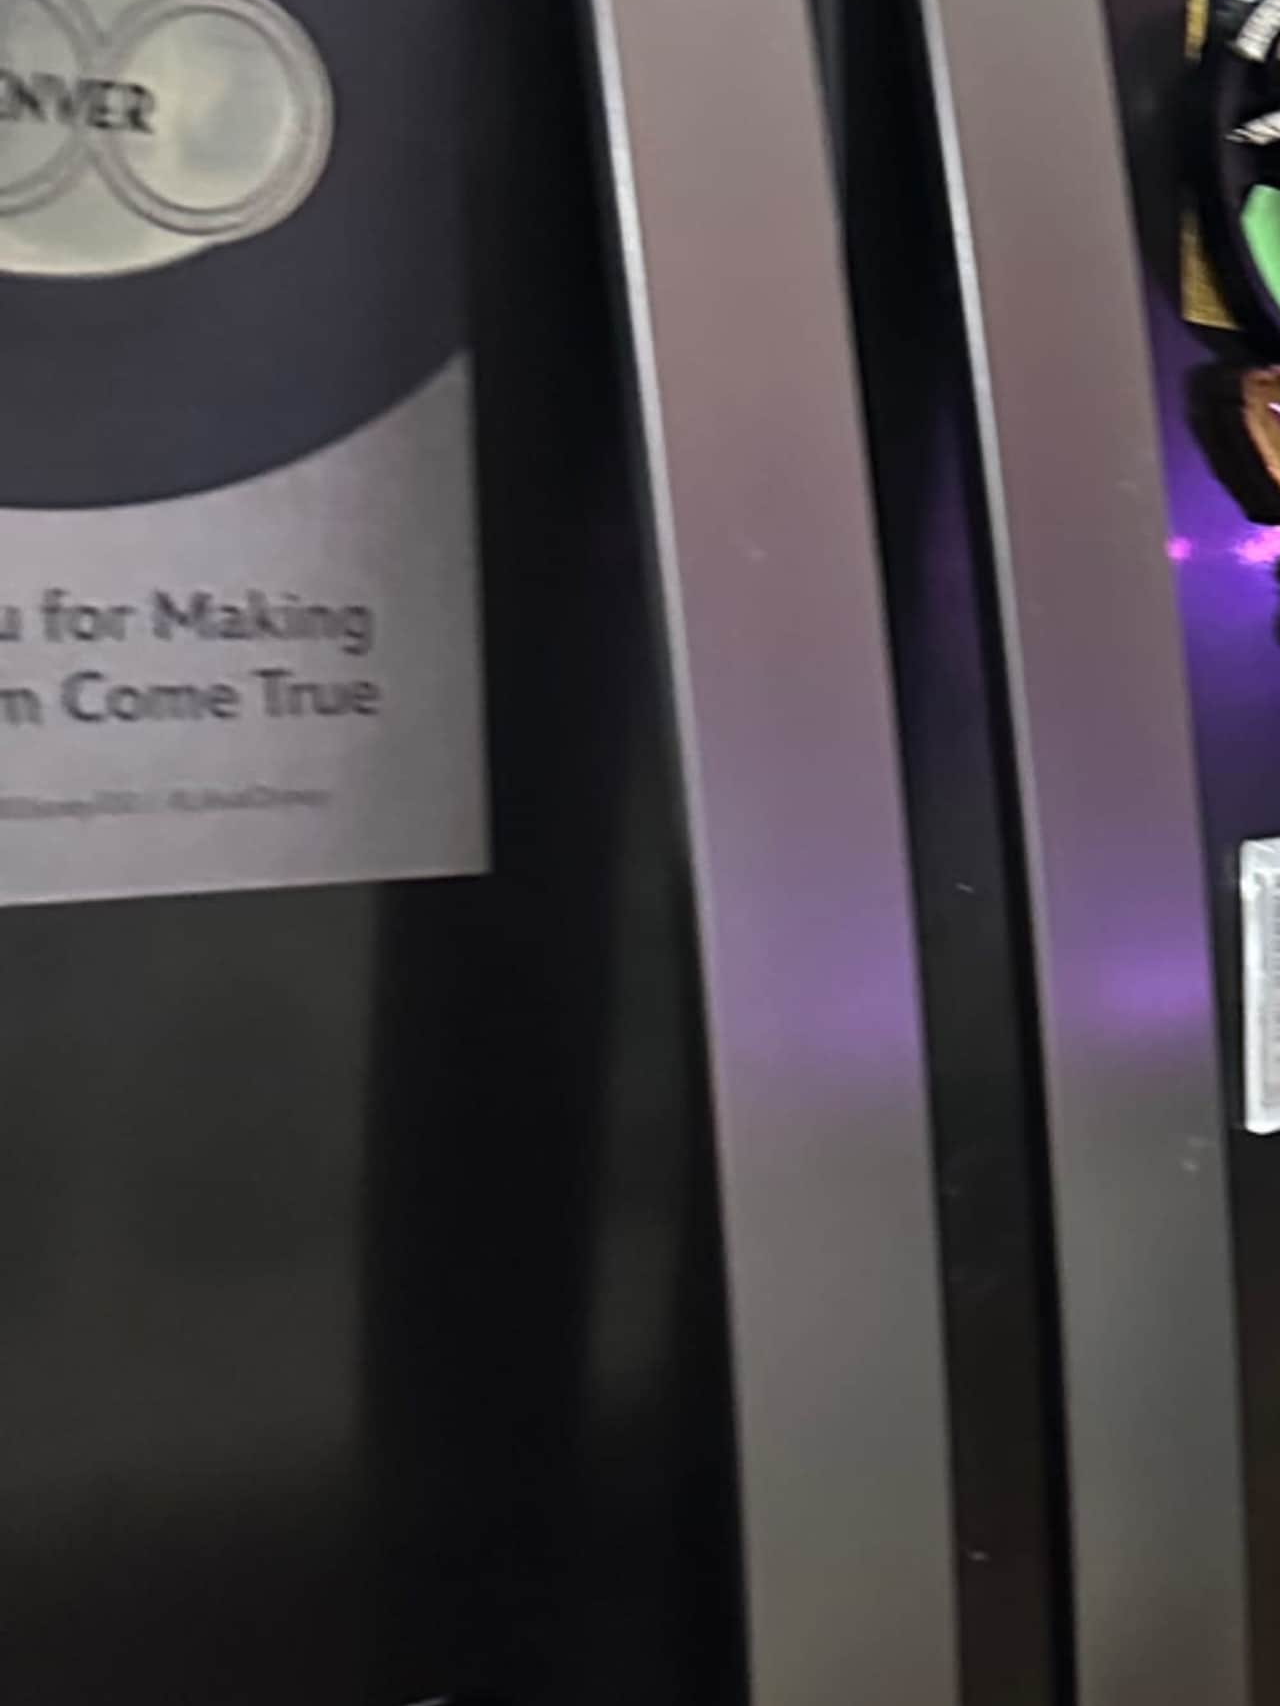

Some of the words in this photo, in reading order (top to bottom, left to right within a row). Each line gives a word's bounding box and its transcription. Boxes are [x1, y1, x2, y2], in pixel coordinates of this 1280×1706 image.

[42, 587, 136, 643] for
[152, 589, 374, 655] Making
[61, 671, 239, 723] Come
[251, 667, 384, 718] True
